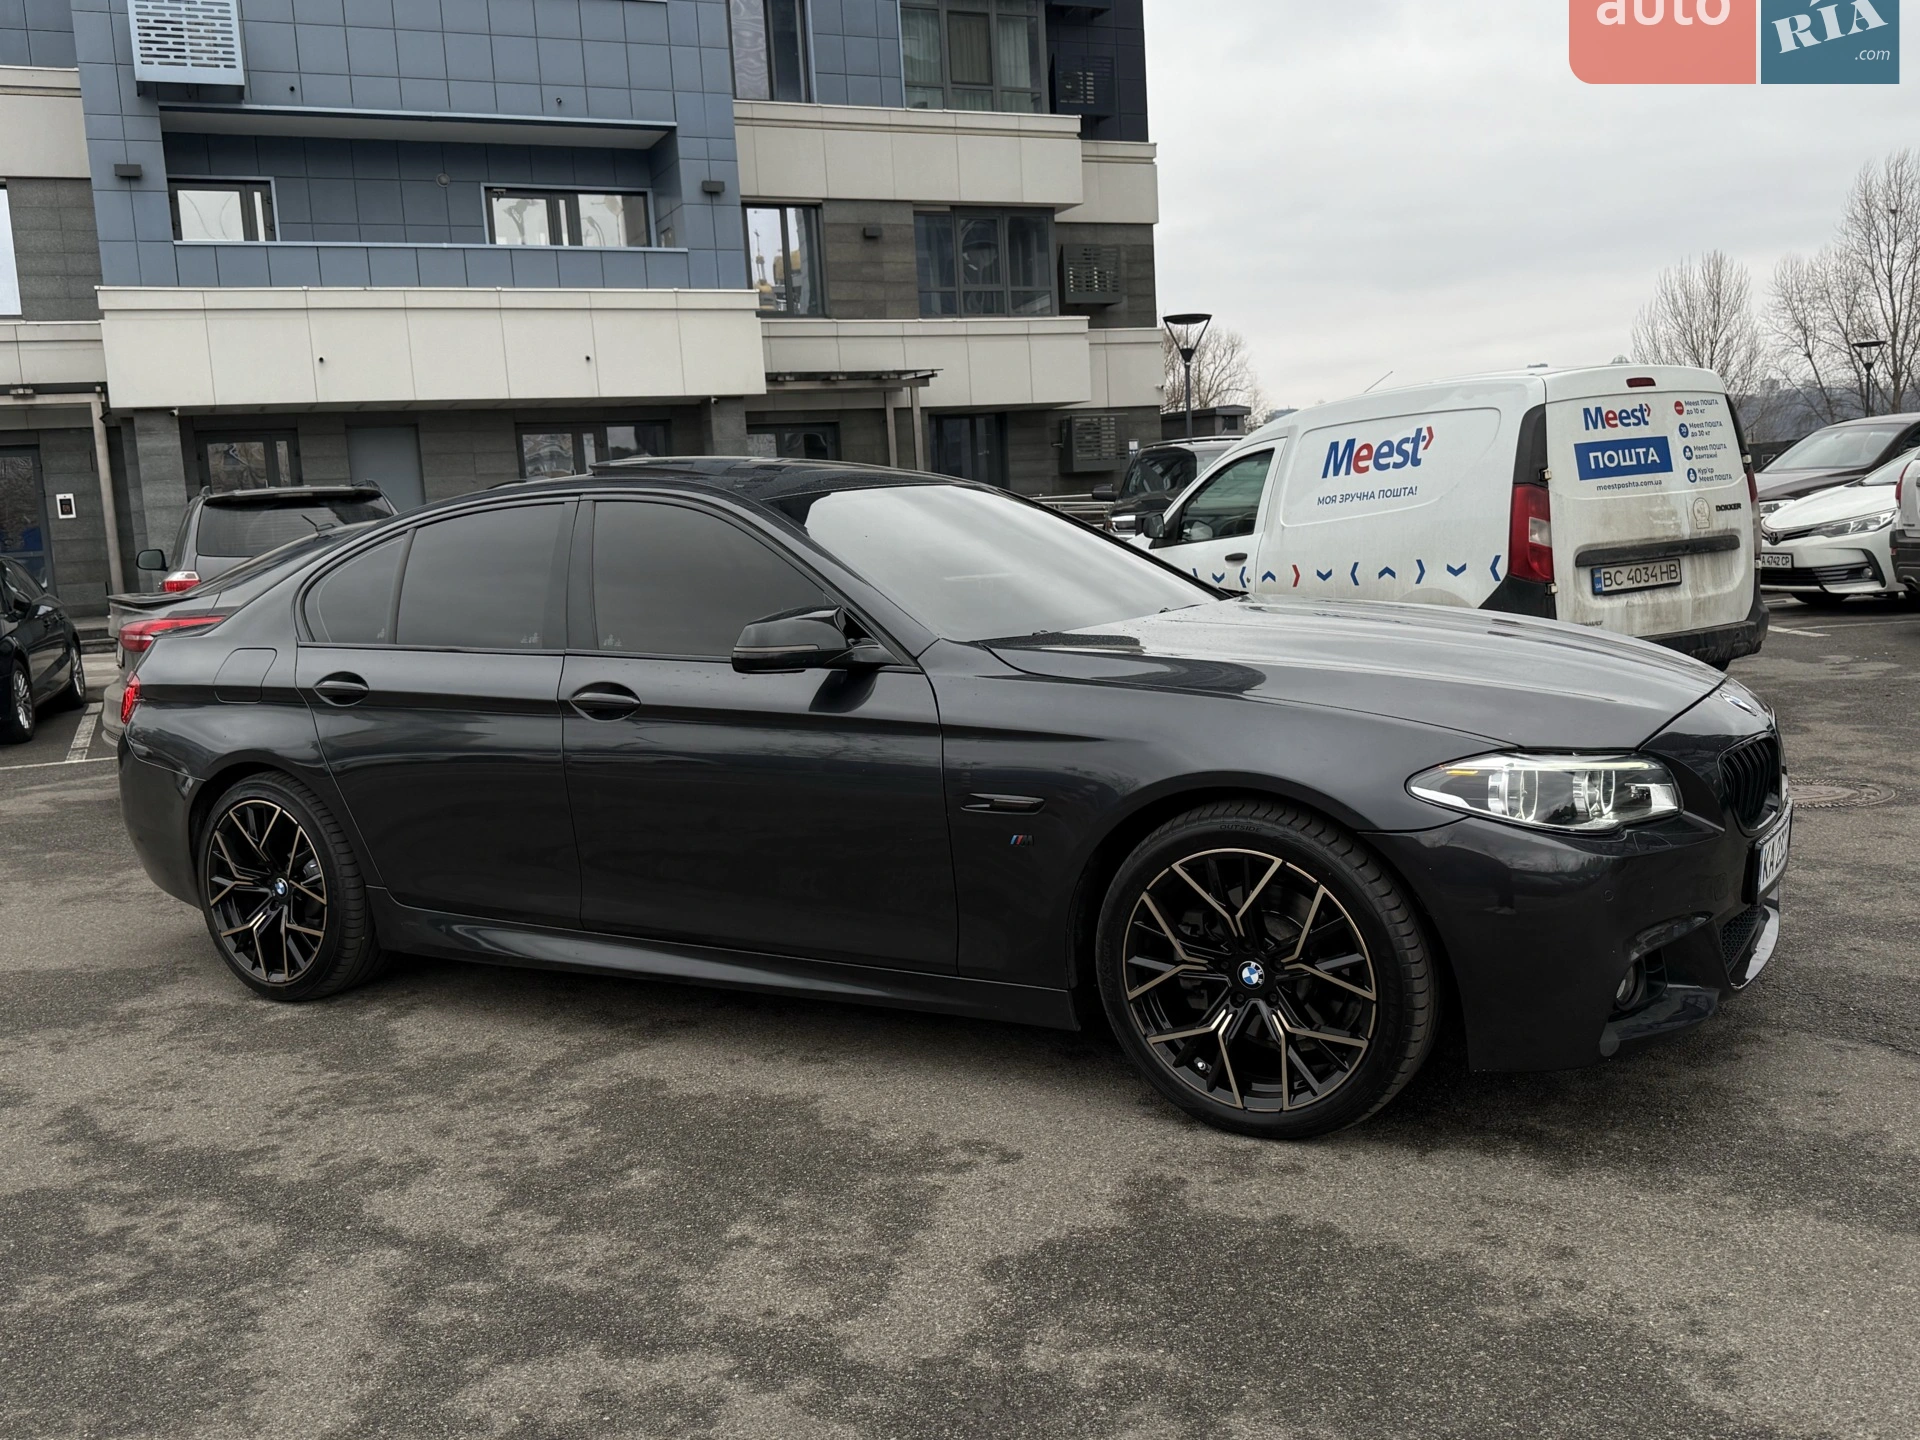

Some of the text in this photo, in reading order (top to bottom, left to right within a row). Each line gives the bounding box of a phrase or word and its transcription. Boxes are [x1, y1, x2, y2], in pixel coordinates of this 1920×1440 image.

[1583, 403, 1650, 431] Meest
[1321, 427, 1424, 479] Meest
[1588, 447, 1660, 470] ПОШТА
[1317, 486, 1418, 506] МОЯ ЗРУЧНА ПОШТА!
[1596, 480, 1662, 491] meestposhta.com.ua
[1715, 503, 1741, 512] DOKKER
[1603, 563, 1678, 588] BC 4034 HB
[1219, 823, 1263, 833] OUTSIDE
